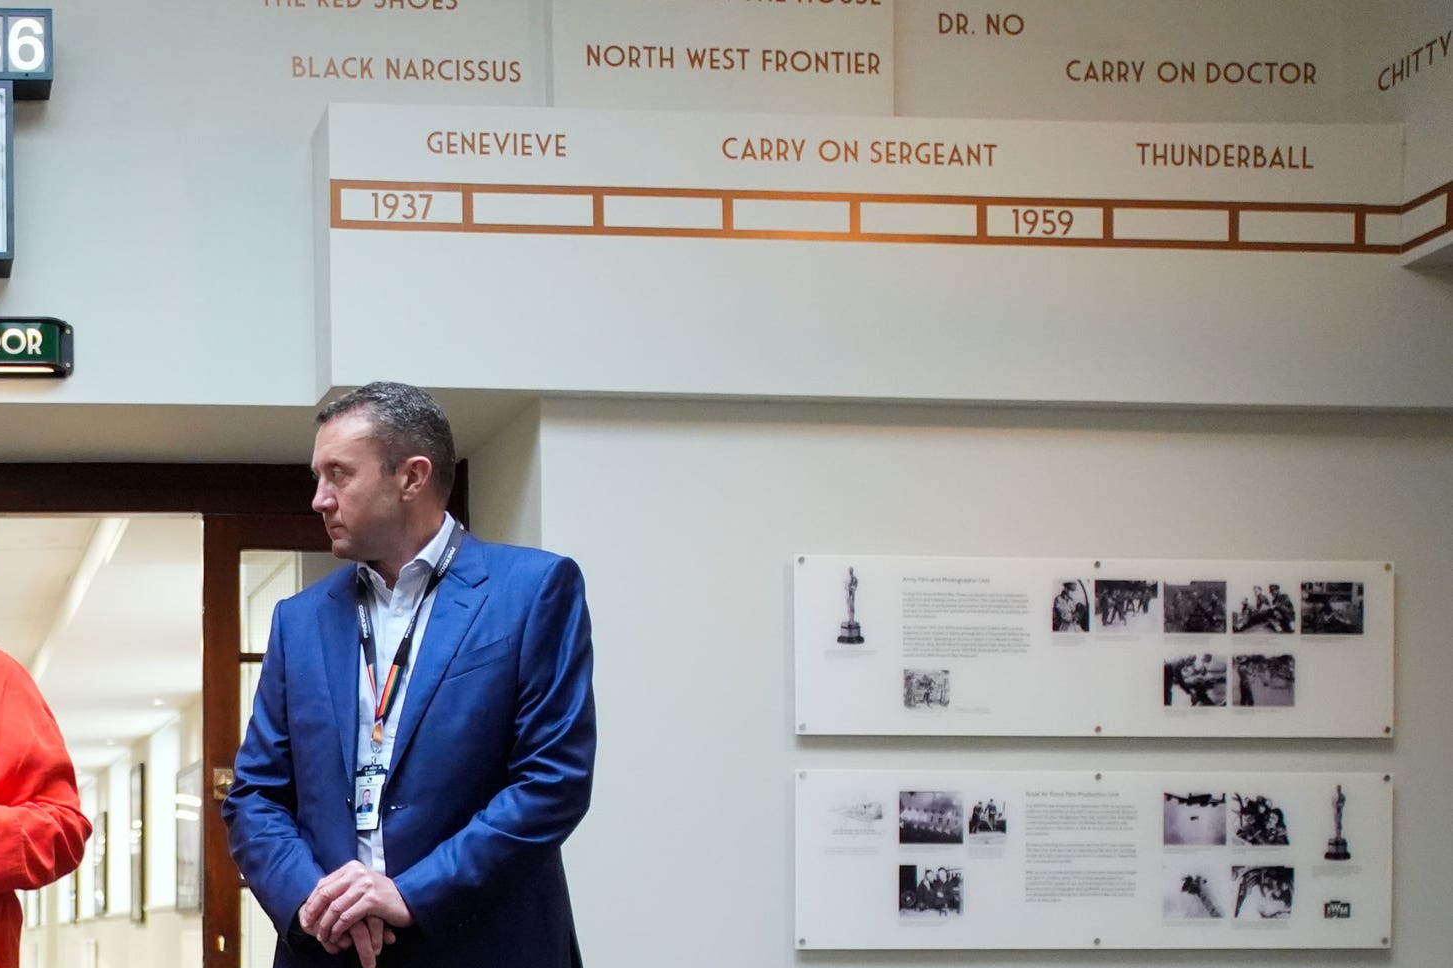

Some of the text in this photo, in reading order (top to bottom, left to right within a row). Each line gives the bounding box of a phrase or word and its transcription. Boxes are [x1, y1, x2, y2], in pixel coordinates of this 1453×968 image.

[938, 13, 1025, 36] DR. NO
[291, 56, 522, 83] BLACK NARCISSUS
[586, 44, 881, 75] NORTH WEST FRONTIER
[1066, 59, 1317, 85] CARRY ON DOCTOR
[1377, 29, 1453, 92] CHITTY
[426, 131, 567, 157] GENEVIEVE
[721, 137, 998, 167] CARRY ON SERGEANT
[1136, 143, 1315, 170] THUNDERBALL
[370, 192, 434, 221] 1937
[1011, 208, 1075, 236] 1959
